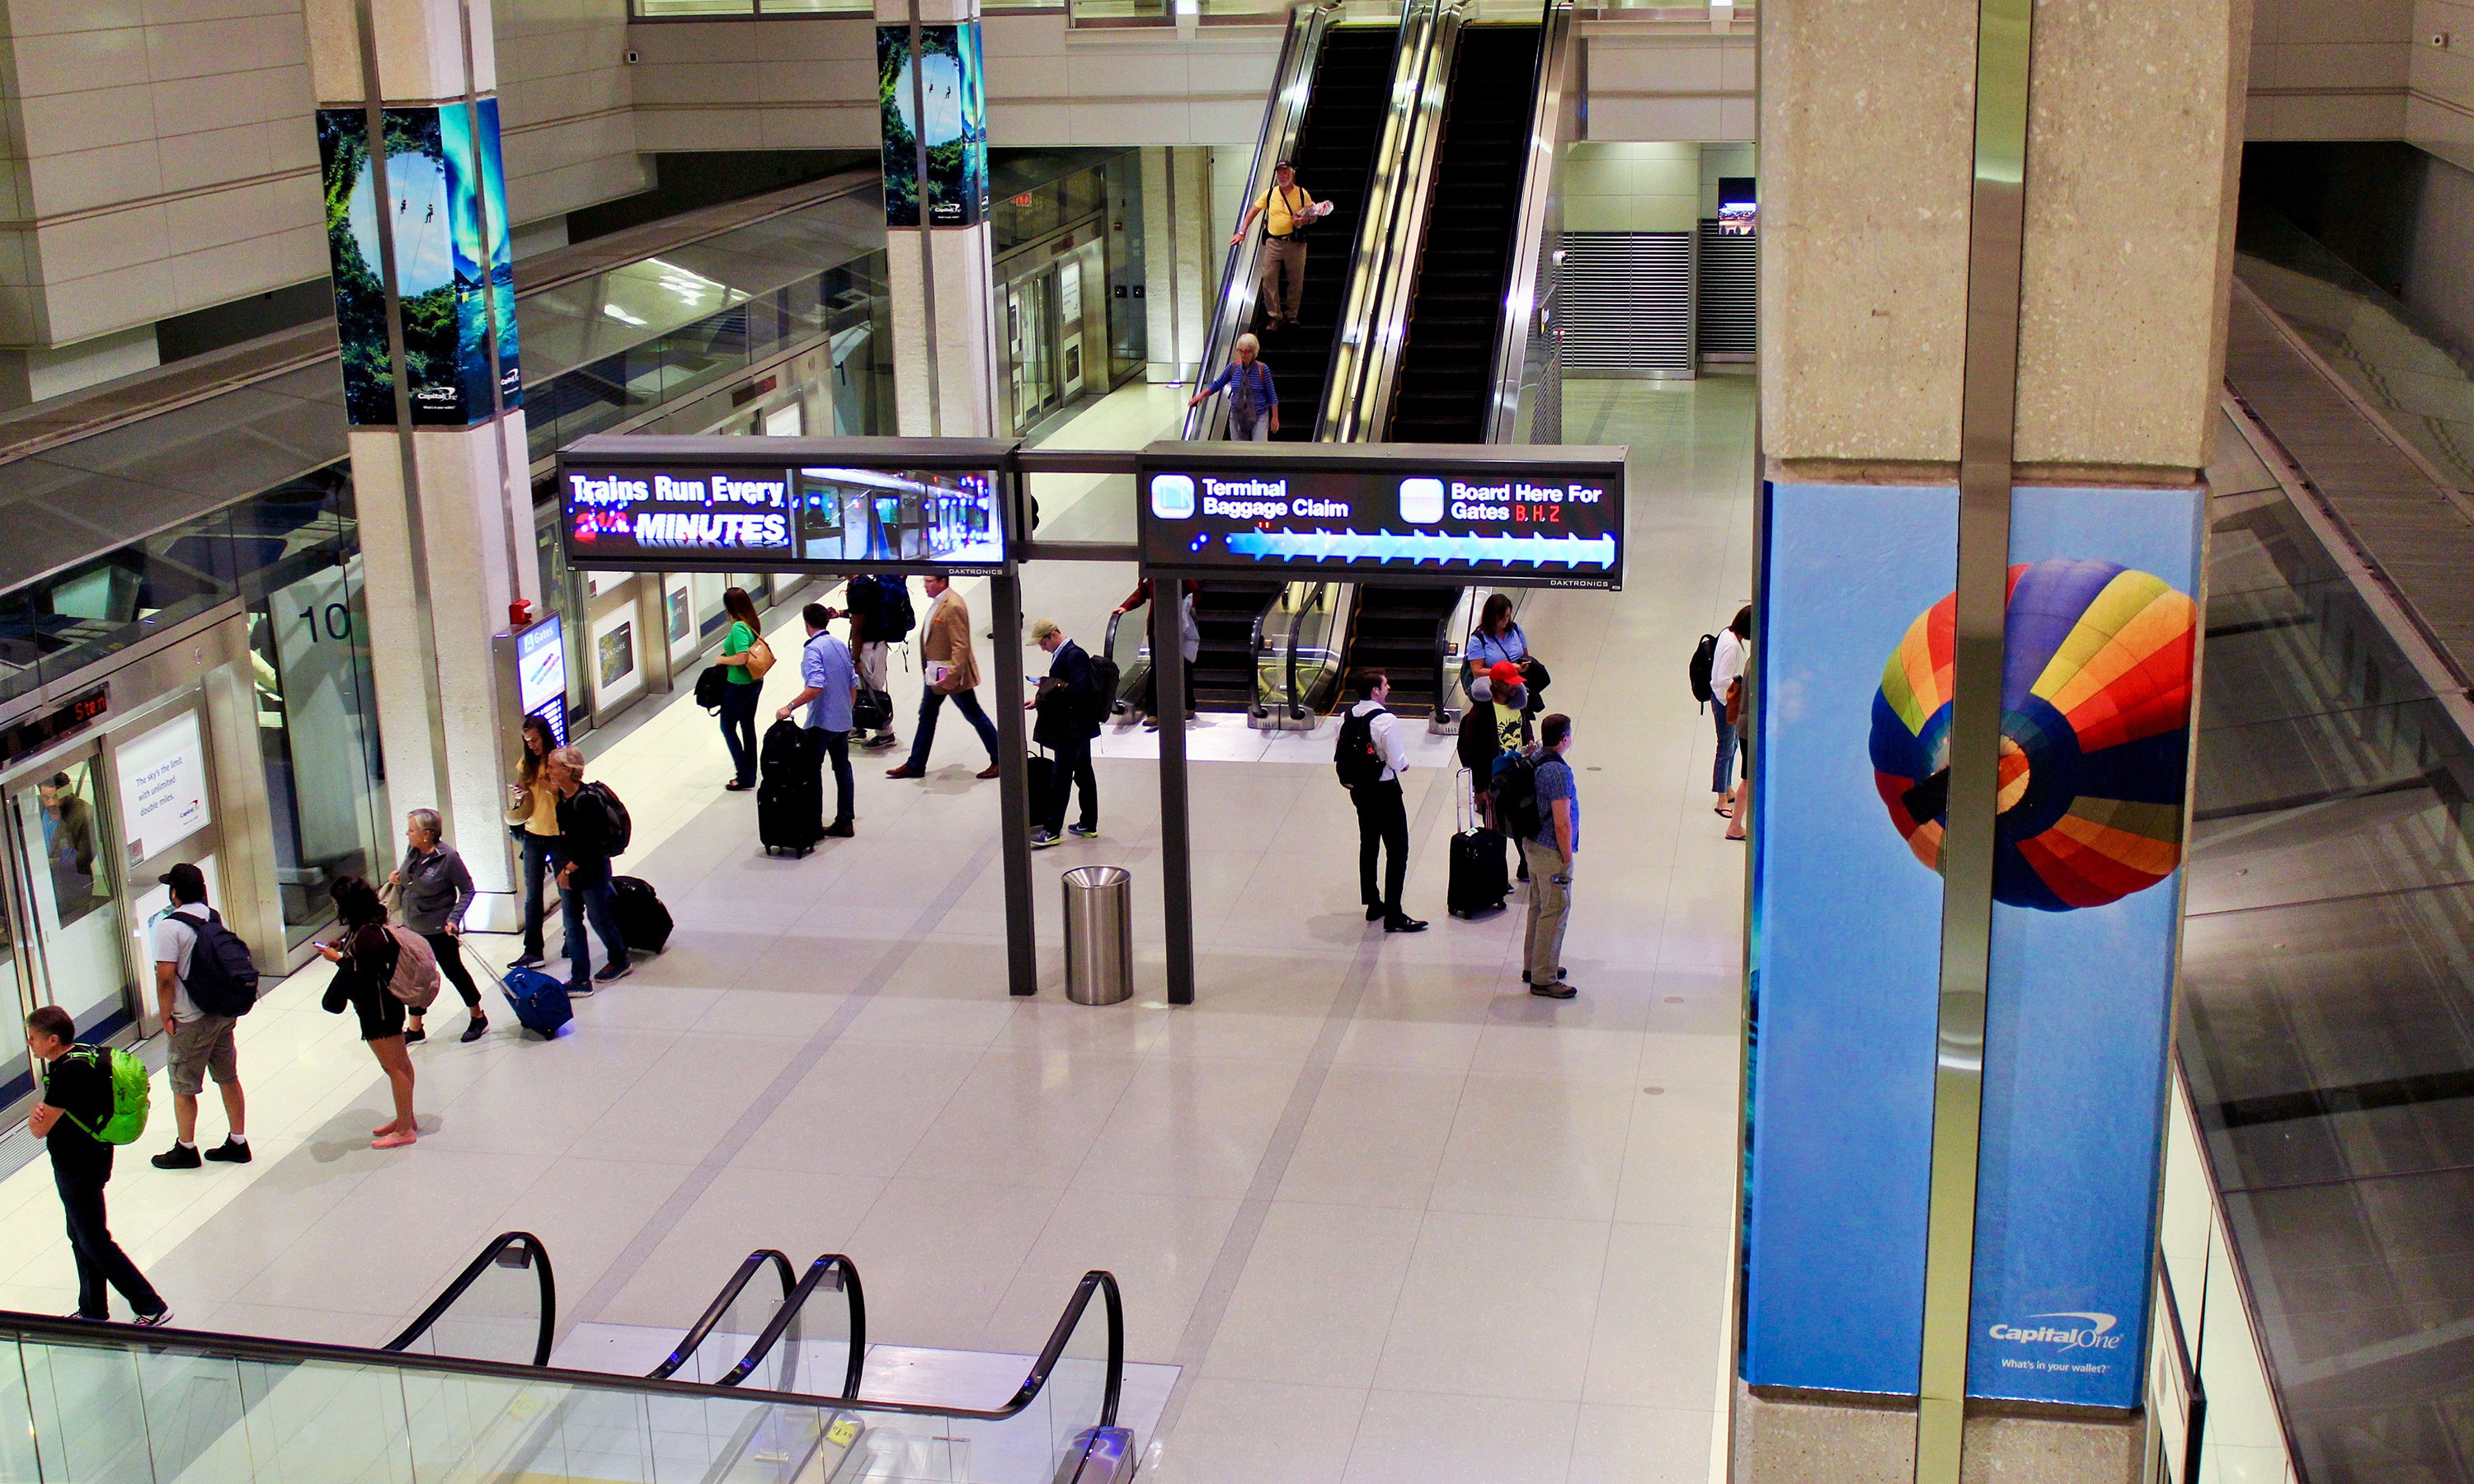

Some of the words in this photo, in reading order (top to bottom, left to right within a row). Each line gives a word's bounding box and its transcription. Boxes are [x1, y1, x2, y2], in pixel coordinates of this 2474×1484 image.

[570, 475, 648, 501] Trains
[654, 475, 705, 501] Run
[711, 476, 784, 507] Every
[1202, 478, 1286, 497] Terminal
[1451, 482, 1510, 501] Board
[1515, 484, 1564, 503] Here
[1568, 485, 1602, 504] For
[1202, 497, 1288, 519] Baggage
[1291, 498, 1349, 518] Claim
[1451, 501, 1510, 521] Gates
[1549, 505, 1561, 523] Z
[636, 513, 786, 541] MINUTES
[1550, 580, 1609, 588] DAKTRONICS
[299, 603, 350, 643] 10
[534, 627, 554, 644] Gates
[136, 777, 147, 787] The
[147, 769, 161, 781] sky's
[161, 763, 170, 774] the
[170, 756, 183, 768] limit
[138, 790, 151, 801] with
[151, 775, 176, 795] unlimited
[140, 801, 158, 817] double
[2001, 1359, 2035, 1370] What's
[2036, 1360, 2046, 1370] in
[2048, 1363, 2070, 1373] your
[2072, 1363, 2107, 1374] wallet?
